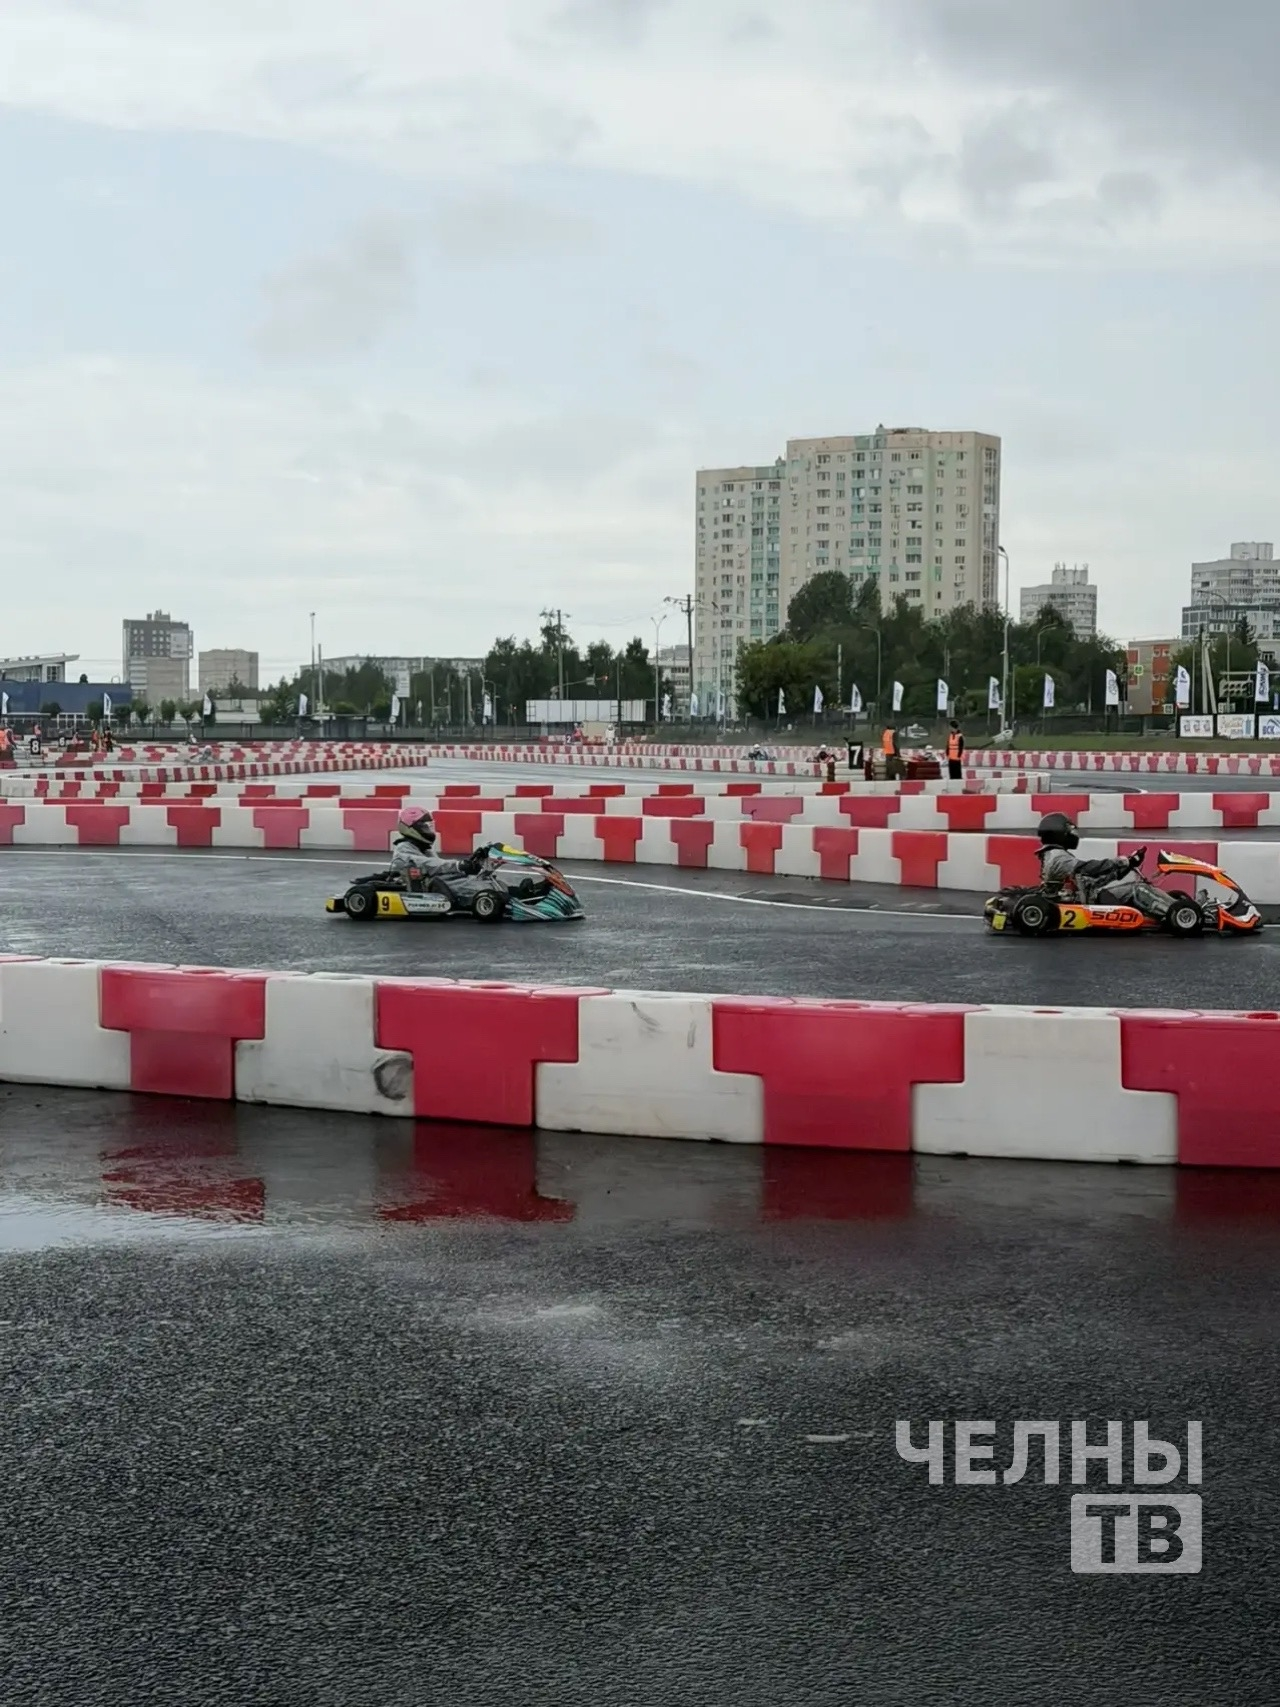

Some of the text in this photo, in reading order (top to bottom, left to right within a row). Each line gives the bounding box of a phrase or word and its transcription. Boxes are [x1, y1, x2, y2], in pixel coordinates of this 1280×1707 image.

[32, 740, 40, 752] 8
[850, 745, 862, 766] 7
[382, 896, 390, 911] 9
[1063, 910, 1077, 928] 2
